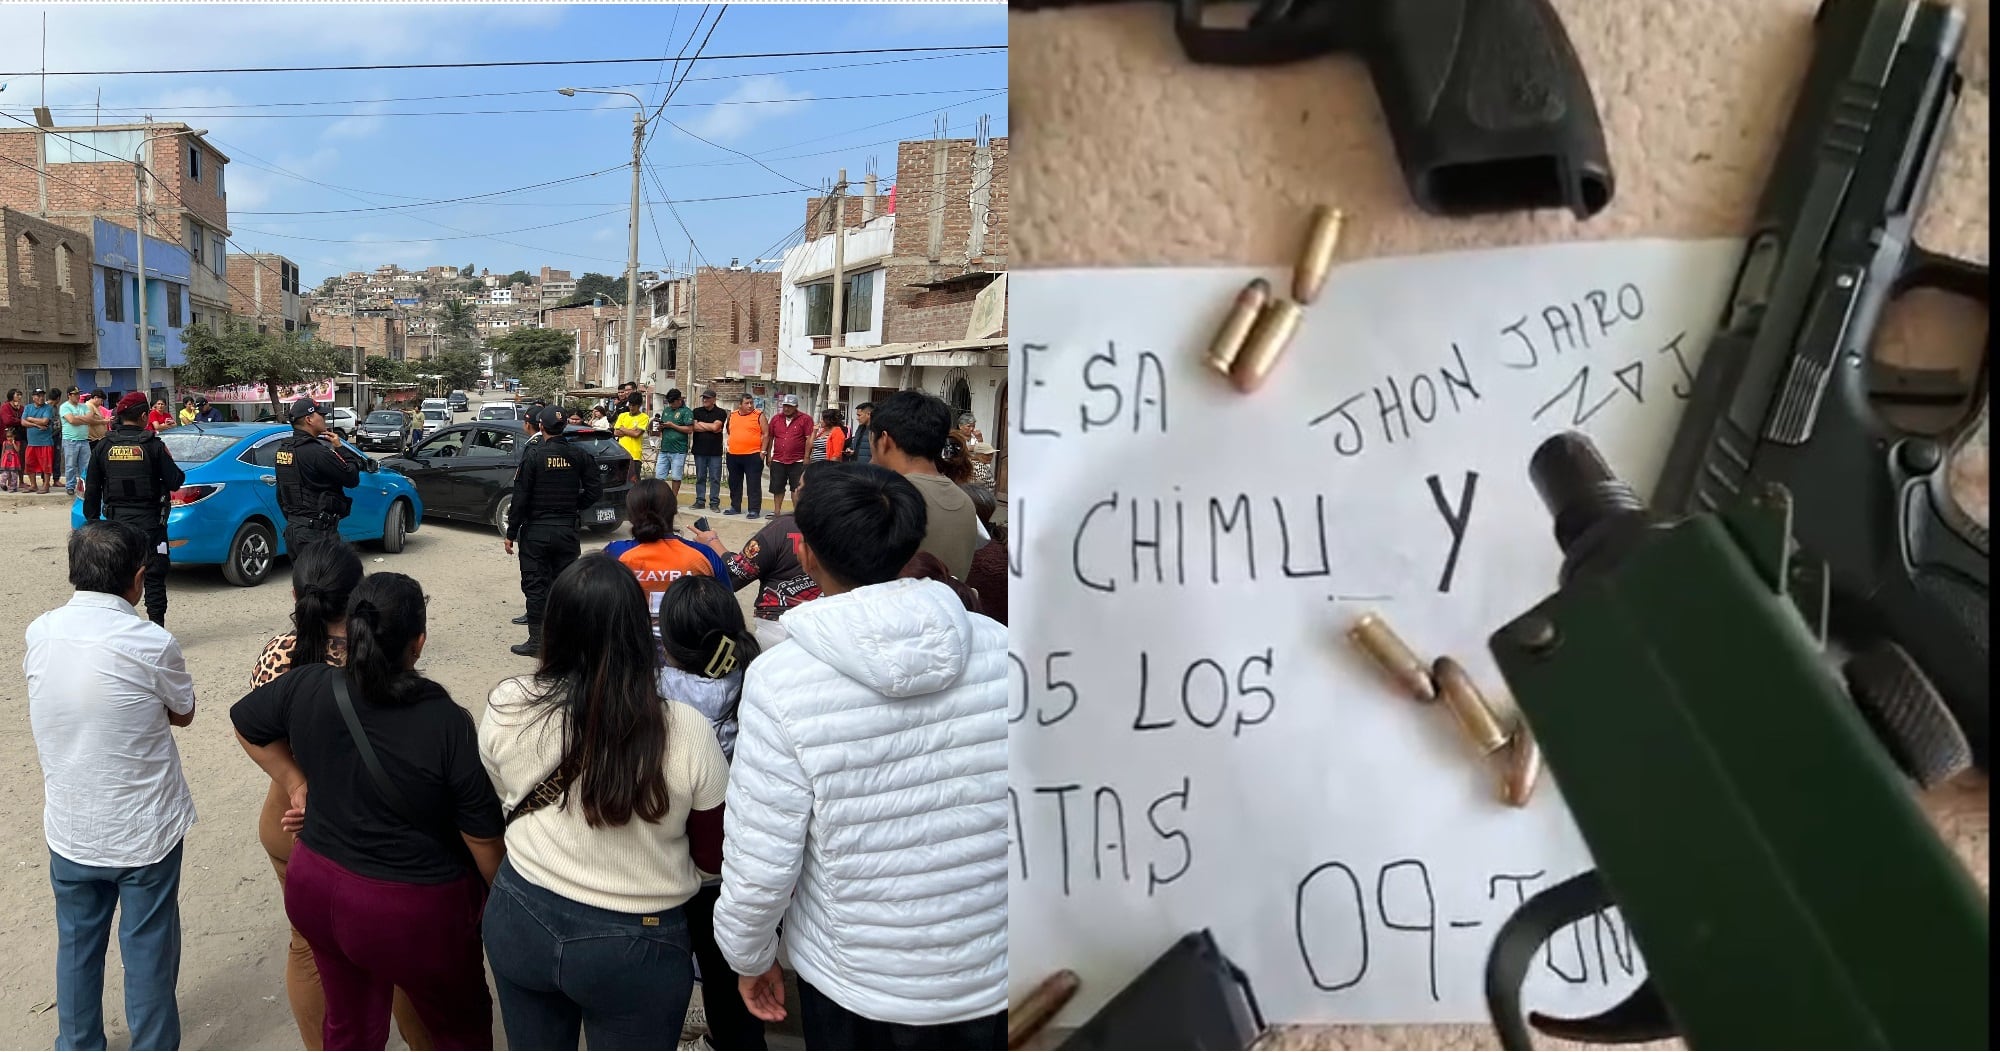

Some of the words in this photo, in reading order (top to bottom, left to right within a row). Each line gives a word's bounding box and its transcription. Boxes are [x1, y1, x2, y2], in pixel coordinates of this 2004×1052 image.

[1308, 342, 1481, 457] JHON
[1500, 282, 1645, 370] JAIRO
[1425, 470, 1480, 594] Y
[1132, 647, 1276, 737] LOS
